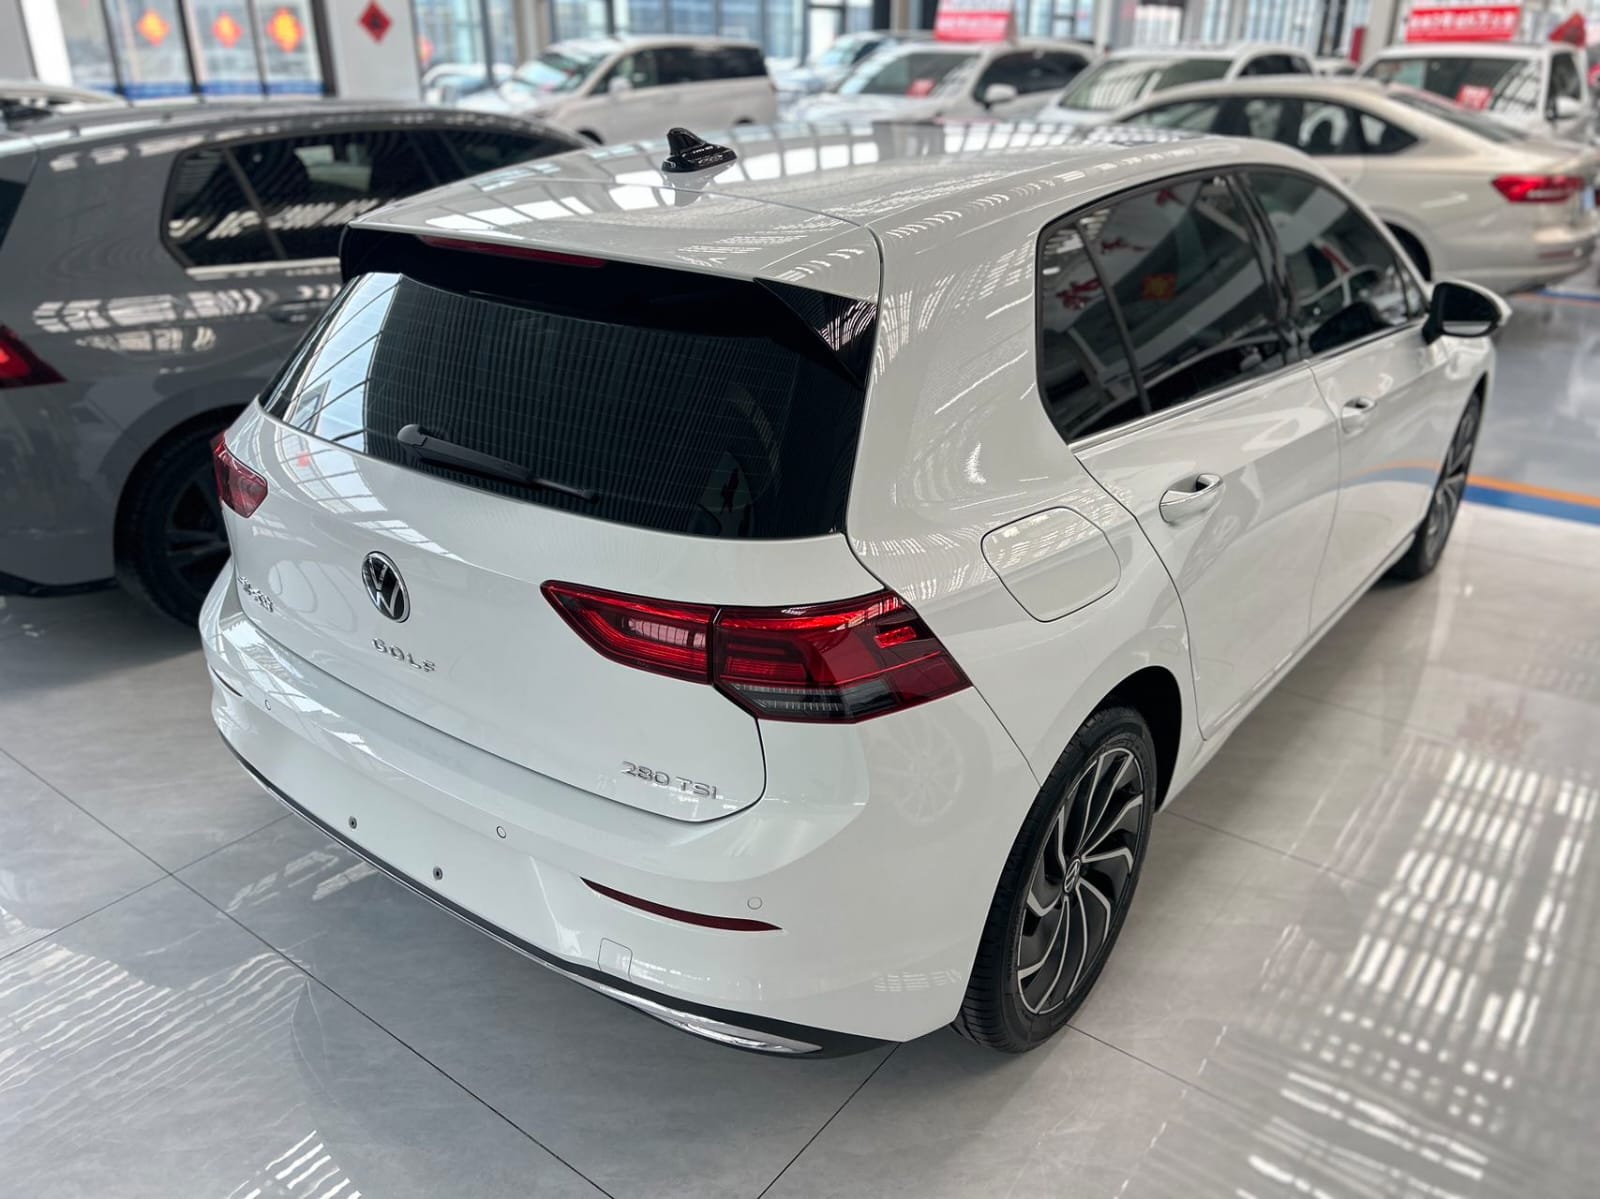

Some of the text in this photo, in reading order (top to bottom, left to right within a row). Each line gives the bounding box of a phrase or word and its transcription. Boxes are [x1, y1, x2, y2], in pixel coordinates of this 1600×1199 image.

[372, 638, 436, 673] GOLF
[620, 761, 717, 800] 280 TSI
